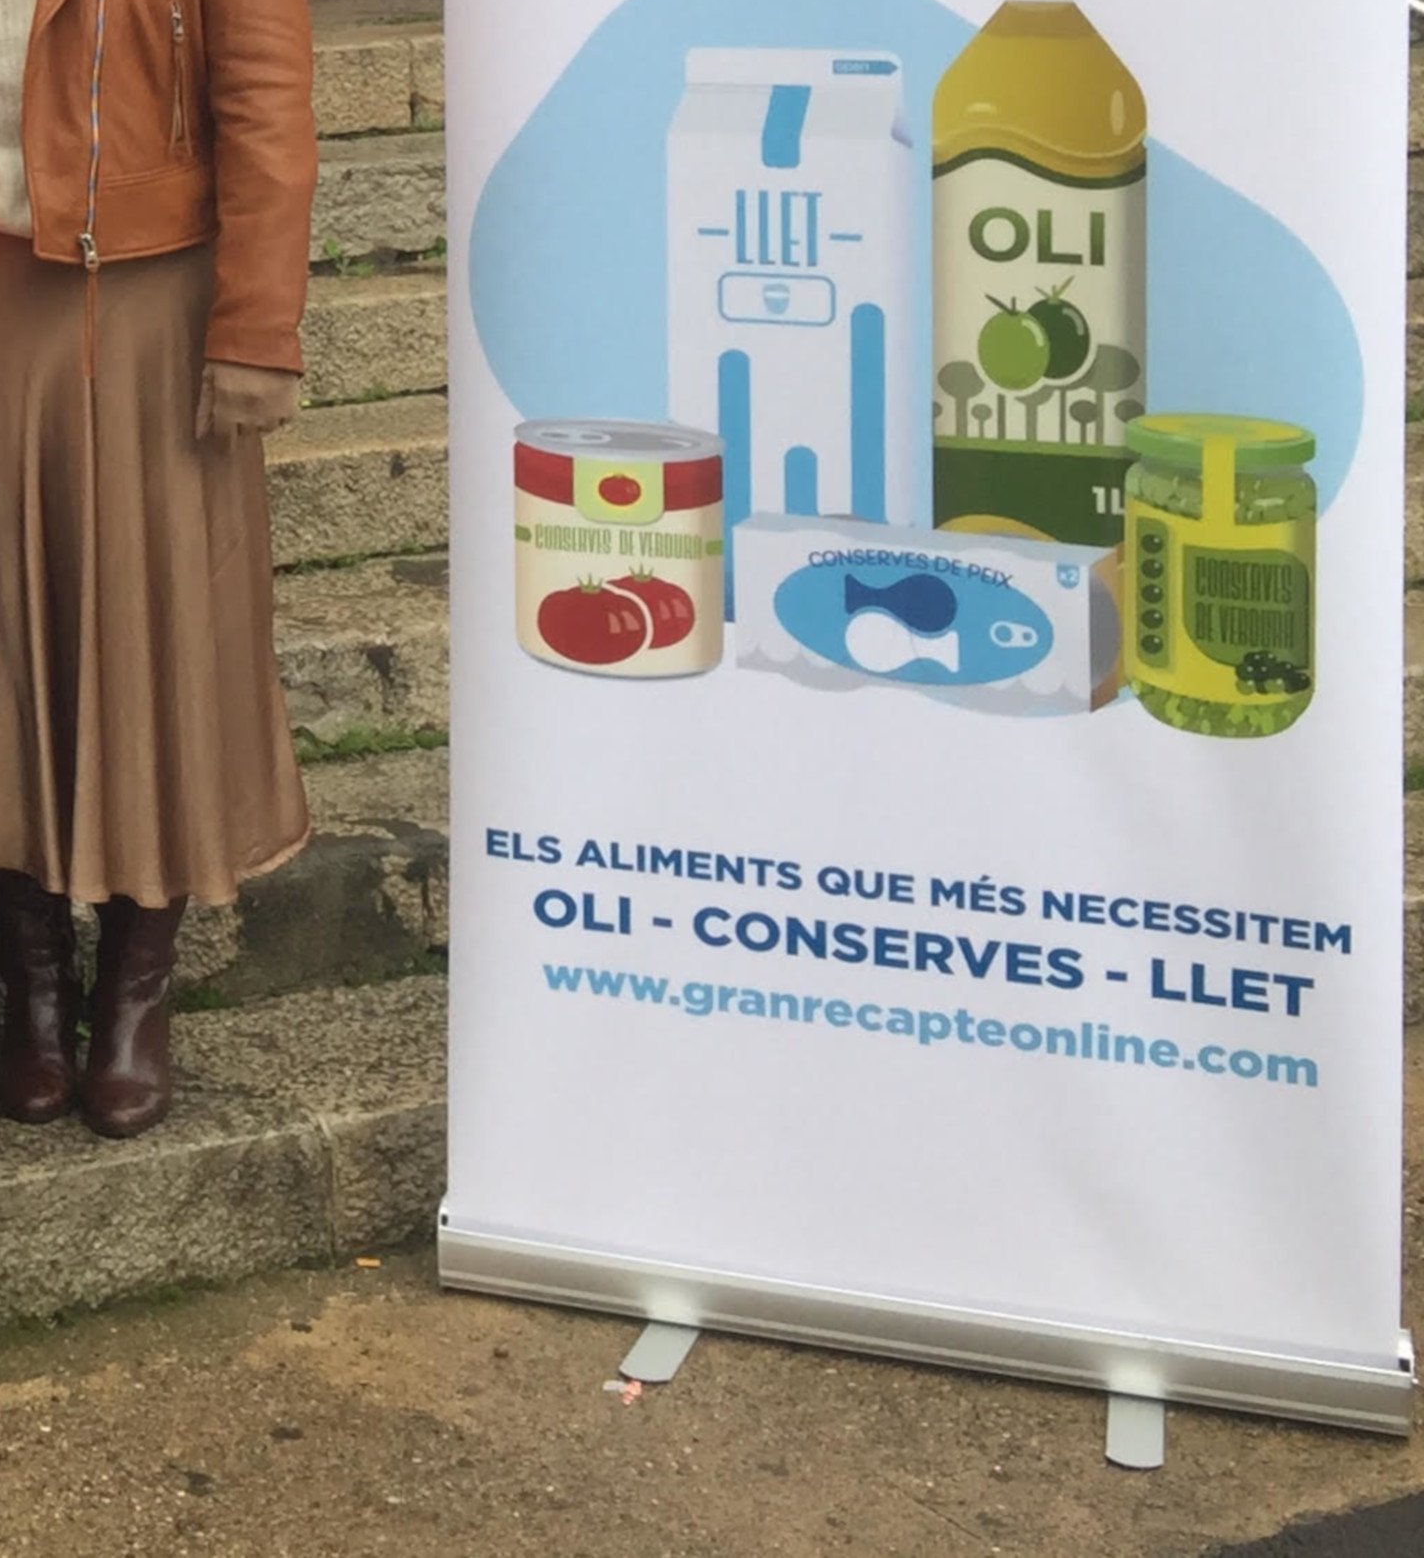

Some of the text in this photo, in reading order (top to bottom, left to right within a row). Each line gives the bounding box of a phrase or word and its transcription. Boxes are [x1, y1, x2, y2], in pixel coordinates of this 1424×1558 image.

[735, 189, 823, 267] LLET
[968, 206, 1106, 266] OLI
[534, 523, 703, 561] CONSERVES DE VERDURA
[808, 548, 1014, 589] CONSERVES DE PEIX
[1195, 556, 1293, 605] CONSERVES
[1195, 601, 1295, 649] DE VERDURA
[484, 828, 1353, 955] ELS ALIMENTS QUE MÉS NECESSITEM
[533, 887, 1316, 1019] OLI - CONSERVES - LLET
[542, 961, 1320, 1088] www.granrecapteonline.com
